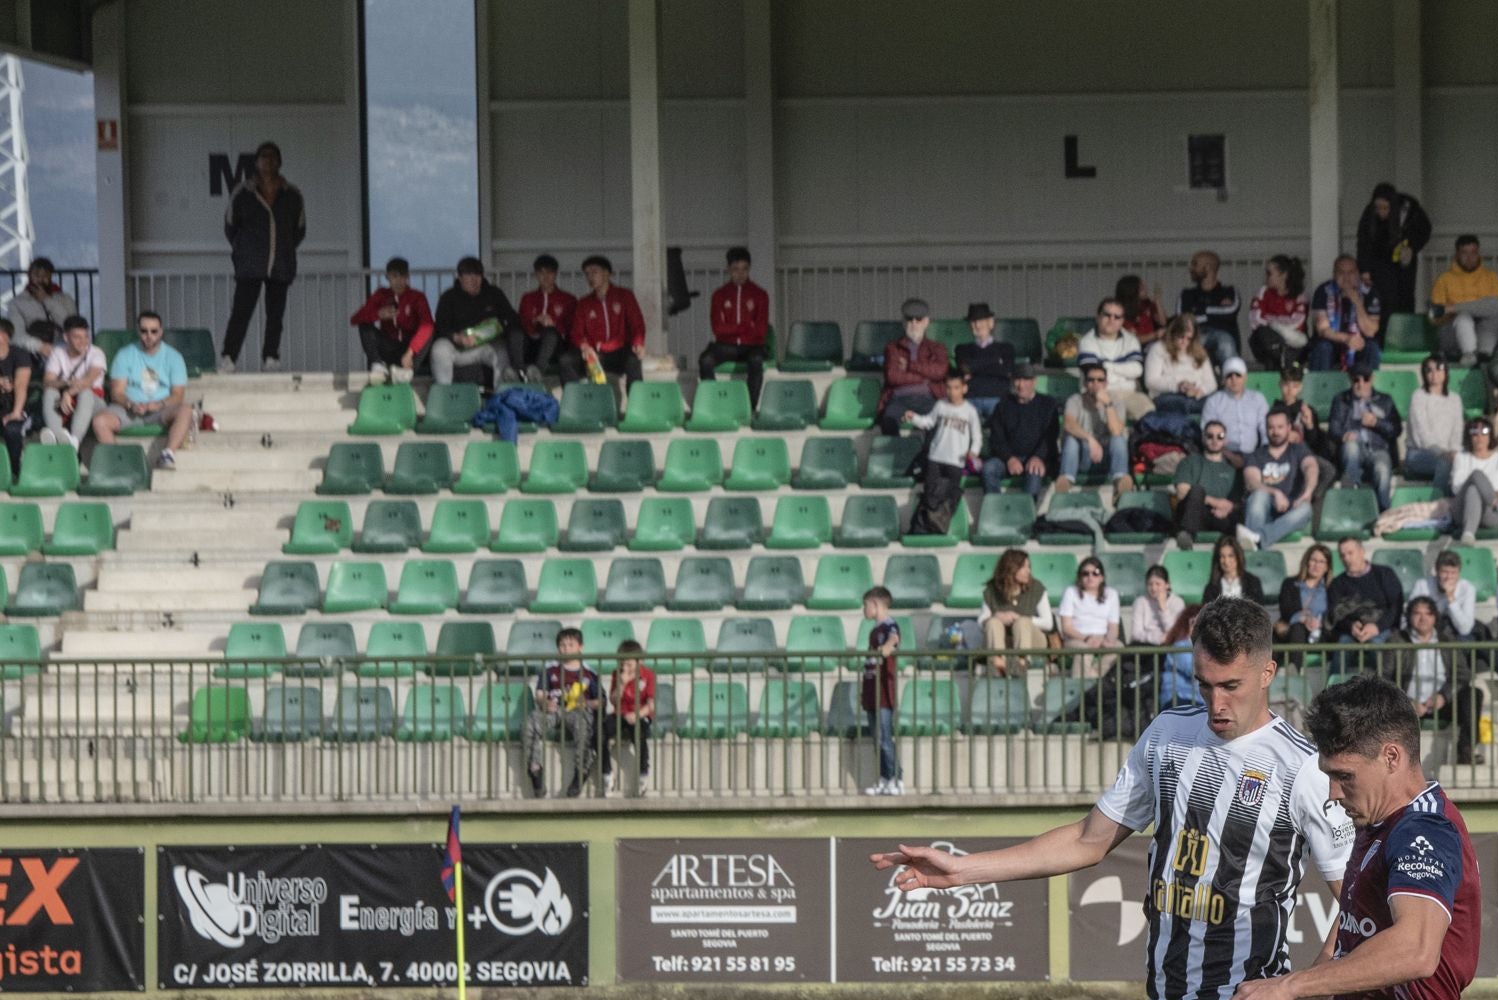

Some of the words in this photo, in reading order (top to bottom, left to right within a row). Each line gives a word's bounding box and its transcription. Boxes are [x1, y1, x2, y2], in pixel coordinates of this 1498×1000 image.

[1064, 134, 1096, 178] L
[210, 154, 256, 196] M
[1398, 855, 1444, 869] HOSPITAL
[1398, 862, 1443, 877] Recoletas
[652, 854, 795, 887] ARTESA
[227, 871, 327, 904] Universo
[651, 888, 754, 903] apartamentos
[757, 889, 767, 899] &
[771, 888, 797, 903] spa
[872, 888, 941, 919] Juan
[947, 887, 1014, 919] Sanz
[339, 894, 438, 936] Energía
[238, 902, 320, 944] Digital
[670, 930, 698, 938] SANTO
[722, 930, 737, 938] DEL
[738, 930, 769, 938] PUERTO
[894, 933, 921, 941] SANTO
[945, 933, 960, 941] DEL
[962, 933, 992, 941] PUERTO
[702, 940, 737, 948] SEGOVIA
[926, 943, 961, 951] SEGOVIA
[652, 956, 688, 971] Telf:
[691, 956, 721, 971] 921
[726, 956, 747, 971] 55
[750, 956, 769, 971] 81
[774, 956, 796, 971] 95
[872, 957, 908, 972] Telf:
[911, 957, 941, 972] 921
[946, 957, 967, 972] 55
[970, 957, 990, 972] 73
[994, 957, 1016, 972] 34
[174, 963, 198, 985] C/
[203, 959, 259, 984] JOSÉ
[263, 962, 374, 986] ZORRILLA,
[476, 961, 571, 982] SEGOVIA
